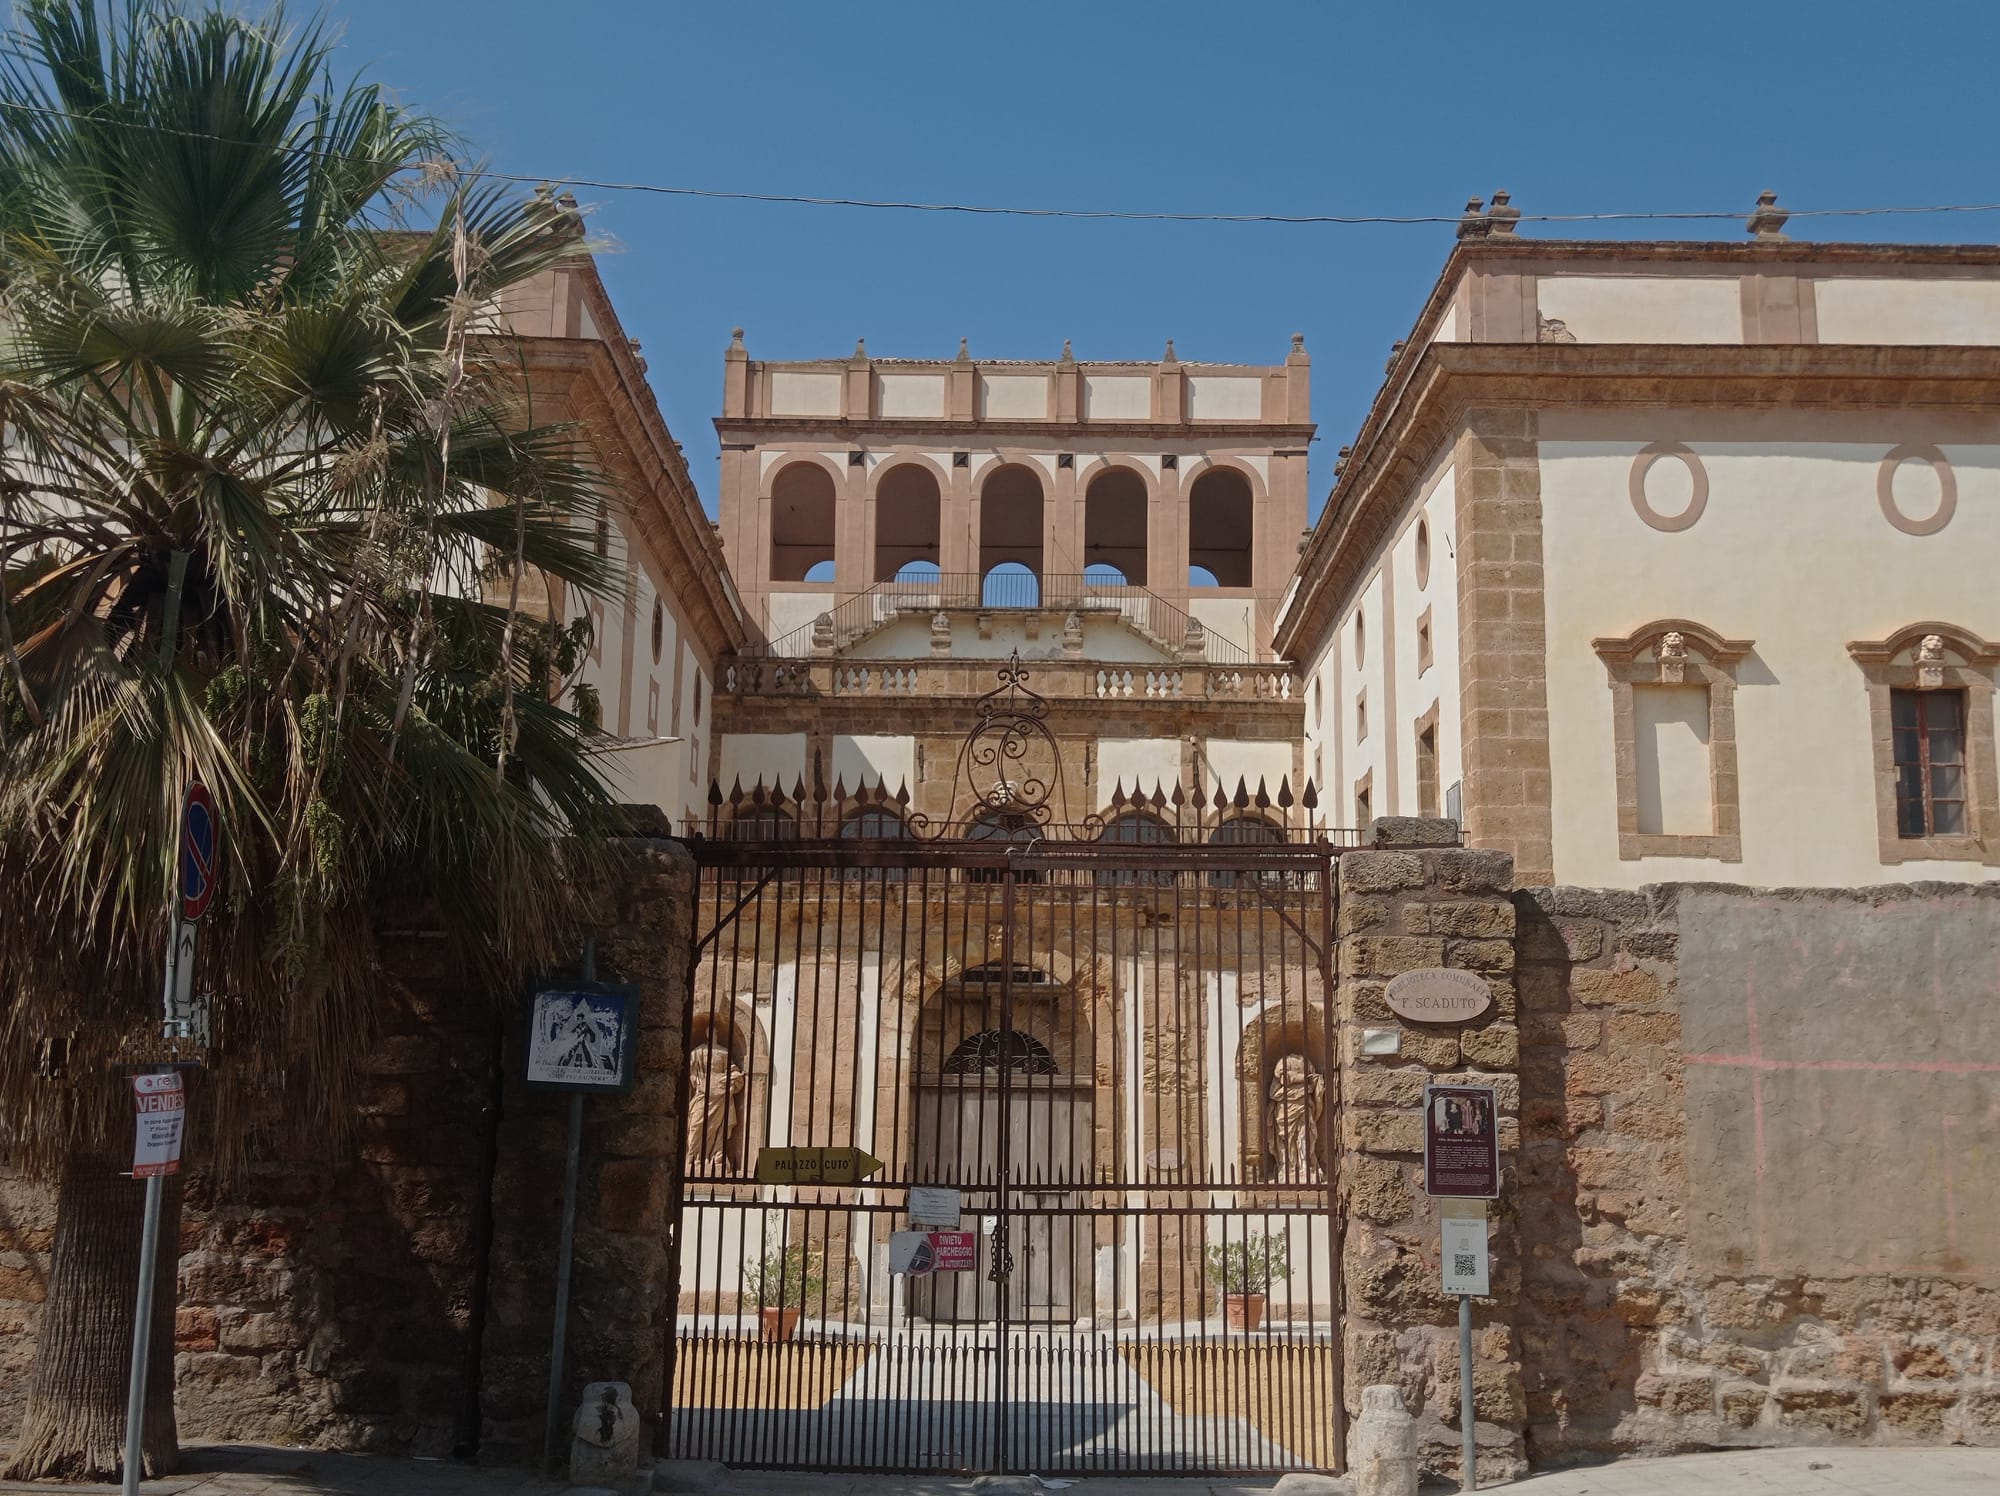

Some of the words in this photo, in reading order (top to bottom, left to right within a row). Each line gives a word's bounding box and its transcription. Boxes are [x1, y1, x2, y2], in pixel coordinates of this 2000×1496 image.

[1390, 972, 1436, 997] BIBLIOTECA
[1442, 972, 1486, 996] COMUNALE
[775, 1160, 817, 1170] PALAZZO
[939, 1234, 962, 1246] DIVIETO
[936, 1246, 973, 1257] PARCHEGGIO
